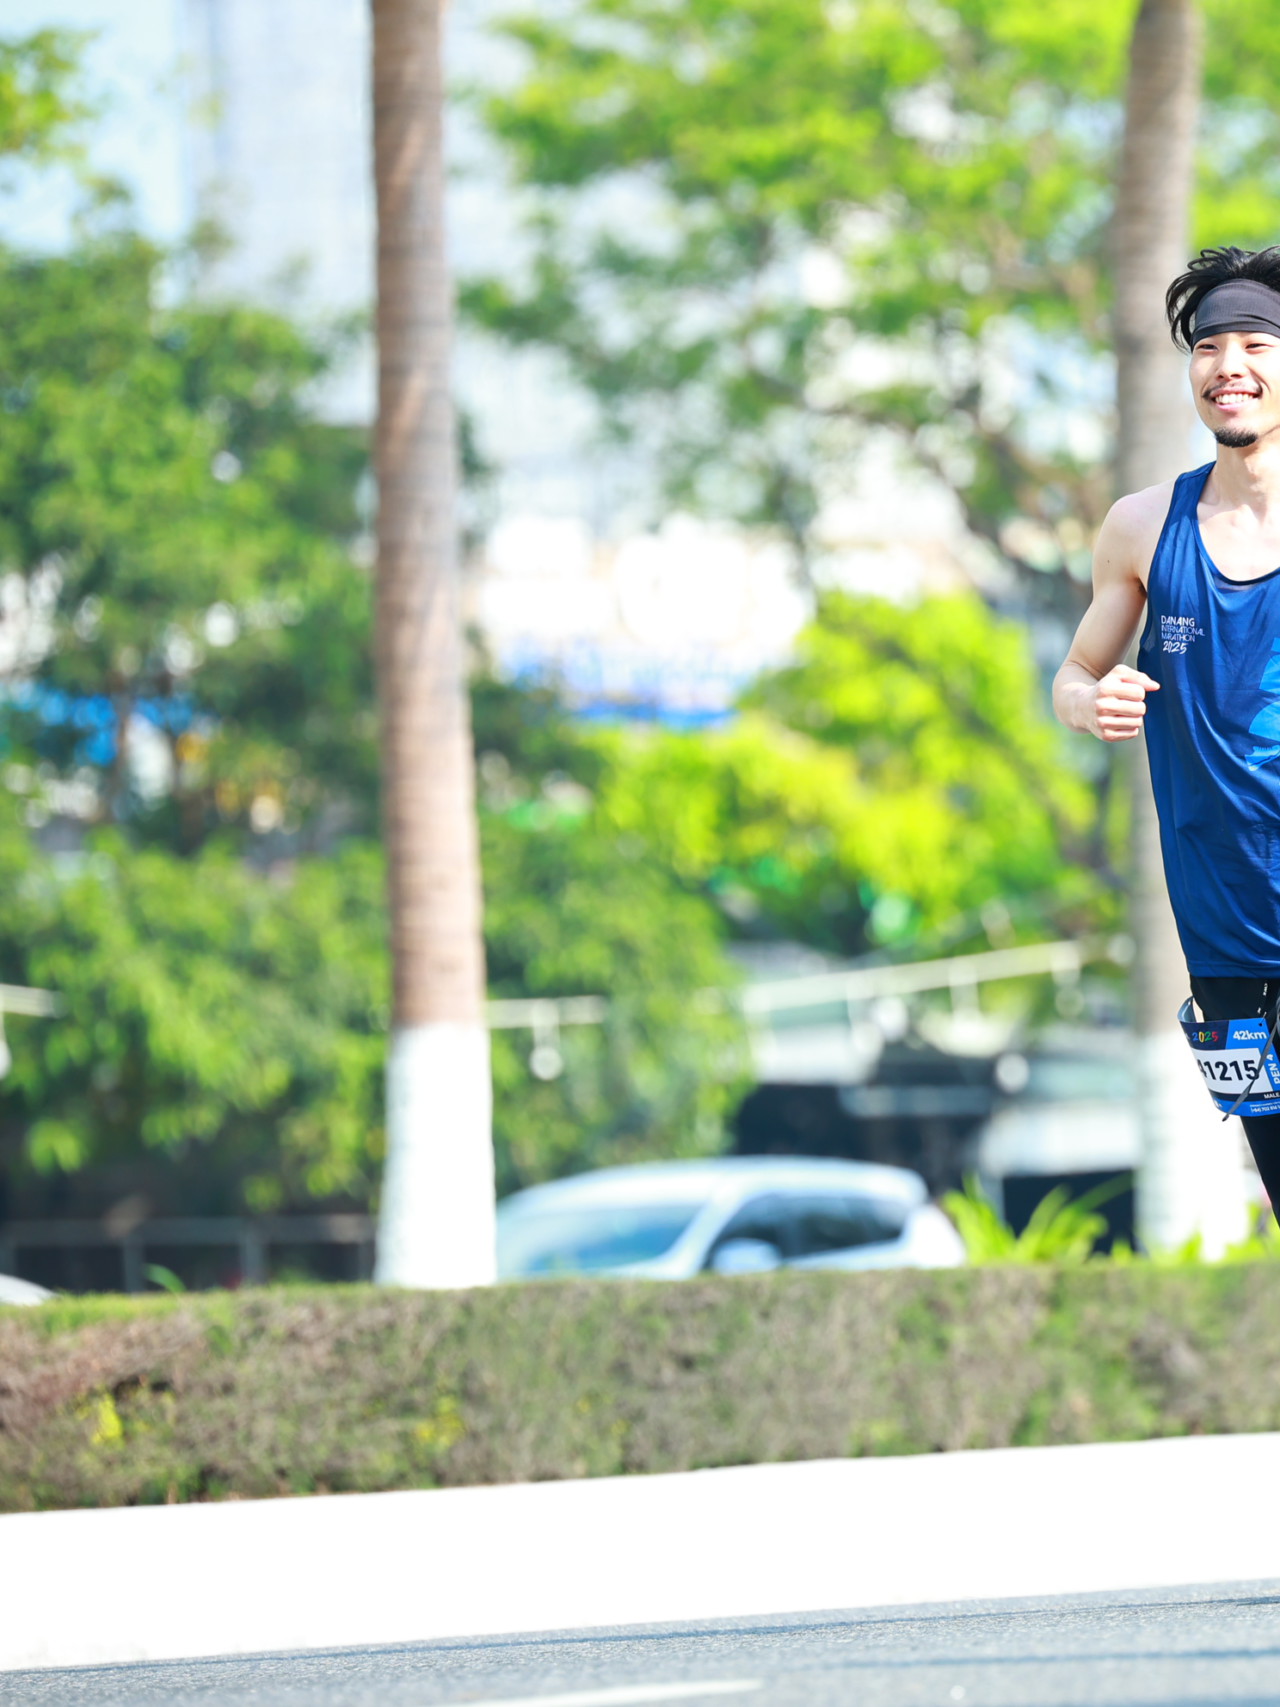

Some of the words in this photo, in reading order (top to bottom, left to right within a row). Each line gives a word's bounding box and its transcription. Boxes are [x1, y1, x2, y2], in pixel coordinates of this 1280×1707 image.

[1161, 615, 1195, 627] DANANG
[1162, 640, 1188, 654] 2025
[1192, 1031, 1219, 1043] 2025
[1233, 1031, 1267, 1041] 42km
